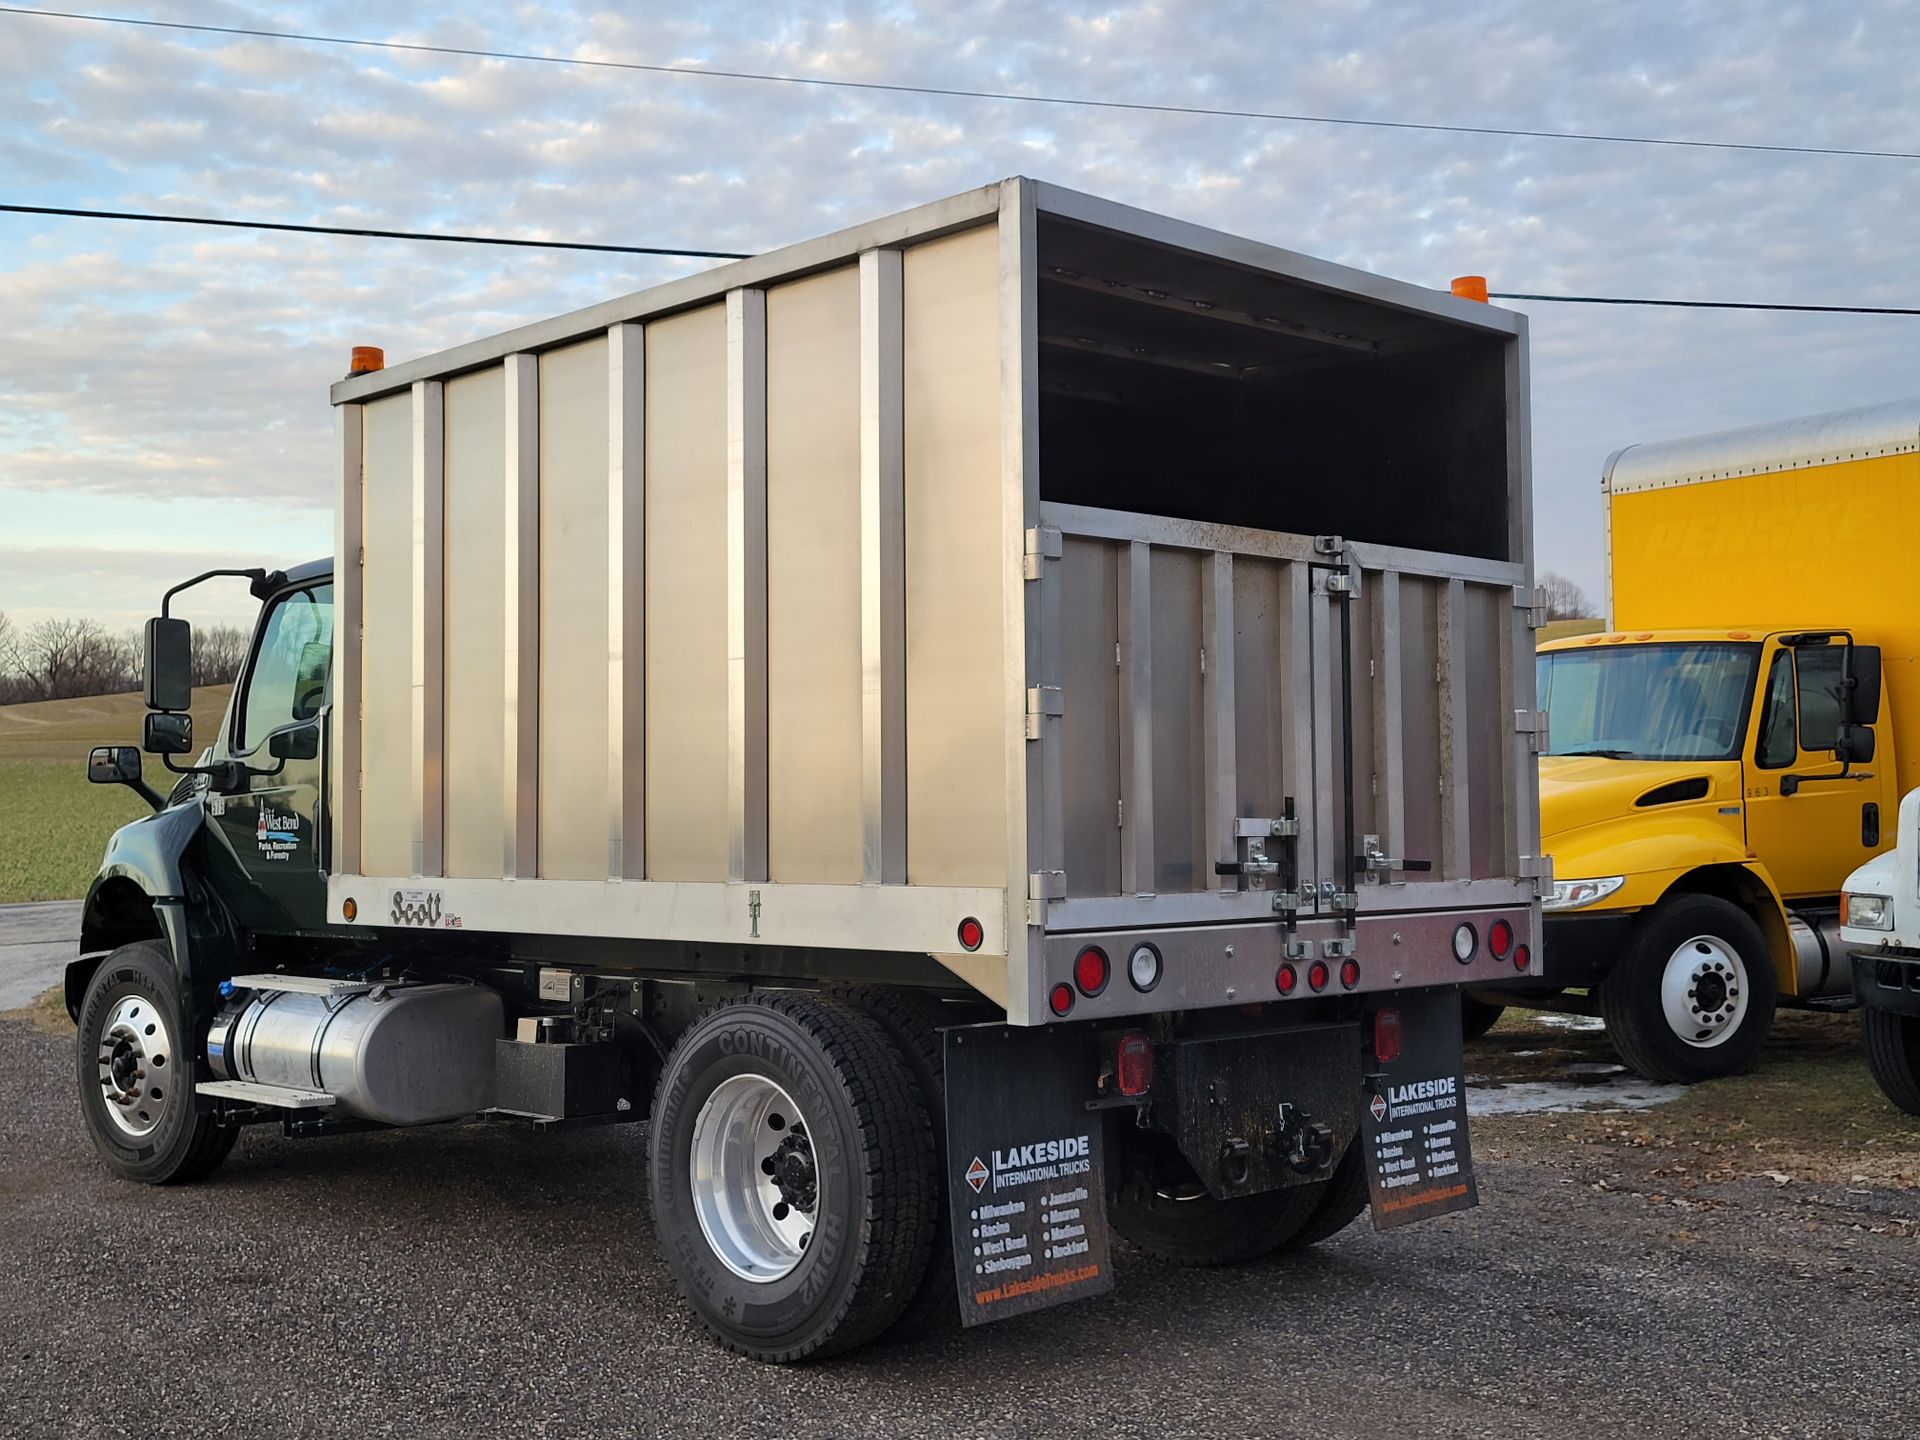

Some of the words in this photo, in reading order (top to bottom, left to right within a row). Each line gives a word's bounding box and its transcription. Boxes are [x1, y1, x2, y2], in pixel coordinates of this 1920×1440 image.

[266, 814, 281, 830] West
[282, 812, 299, 830] Bend
[1391, 1077, 1456, 1103] LAKESIDE
[1391, 1101, 1436, 1118] INTERNATIONAL
[1435, 1096, 1457, 1110] TRUCKS
[995, 1135, 1089, 1170] LAKESIDE
[718, 1029, 842, 1185] CONTINENTAL
[797, 1212, 843, 1307] HDW2
[996, 1165, 1059, 1188] INTERNATIONAL
[1059, 1159, 1090, 1177] TRUCKS
[1049, 1187, 1088, 1206] Janesville
[980, 1201, 1025, 1220] Milwaukee
[1050, 1208, 1080, 1224] Monroe
[981, 1222, 1010, 1238] Racine
[1051, 1224, 1085, 1241] Madison
[982, 1240, 1005, 1256] West
[1005, 1234, 1027, 1251] Bend
[1052, 1239, 1089, 1258] Rockford
[984, 1254, 1032, 1274] Sheboygan
[976, 1265, 1098, 1306] www.LakesideTrucks.com
